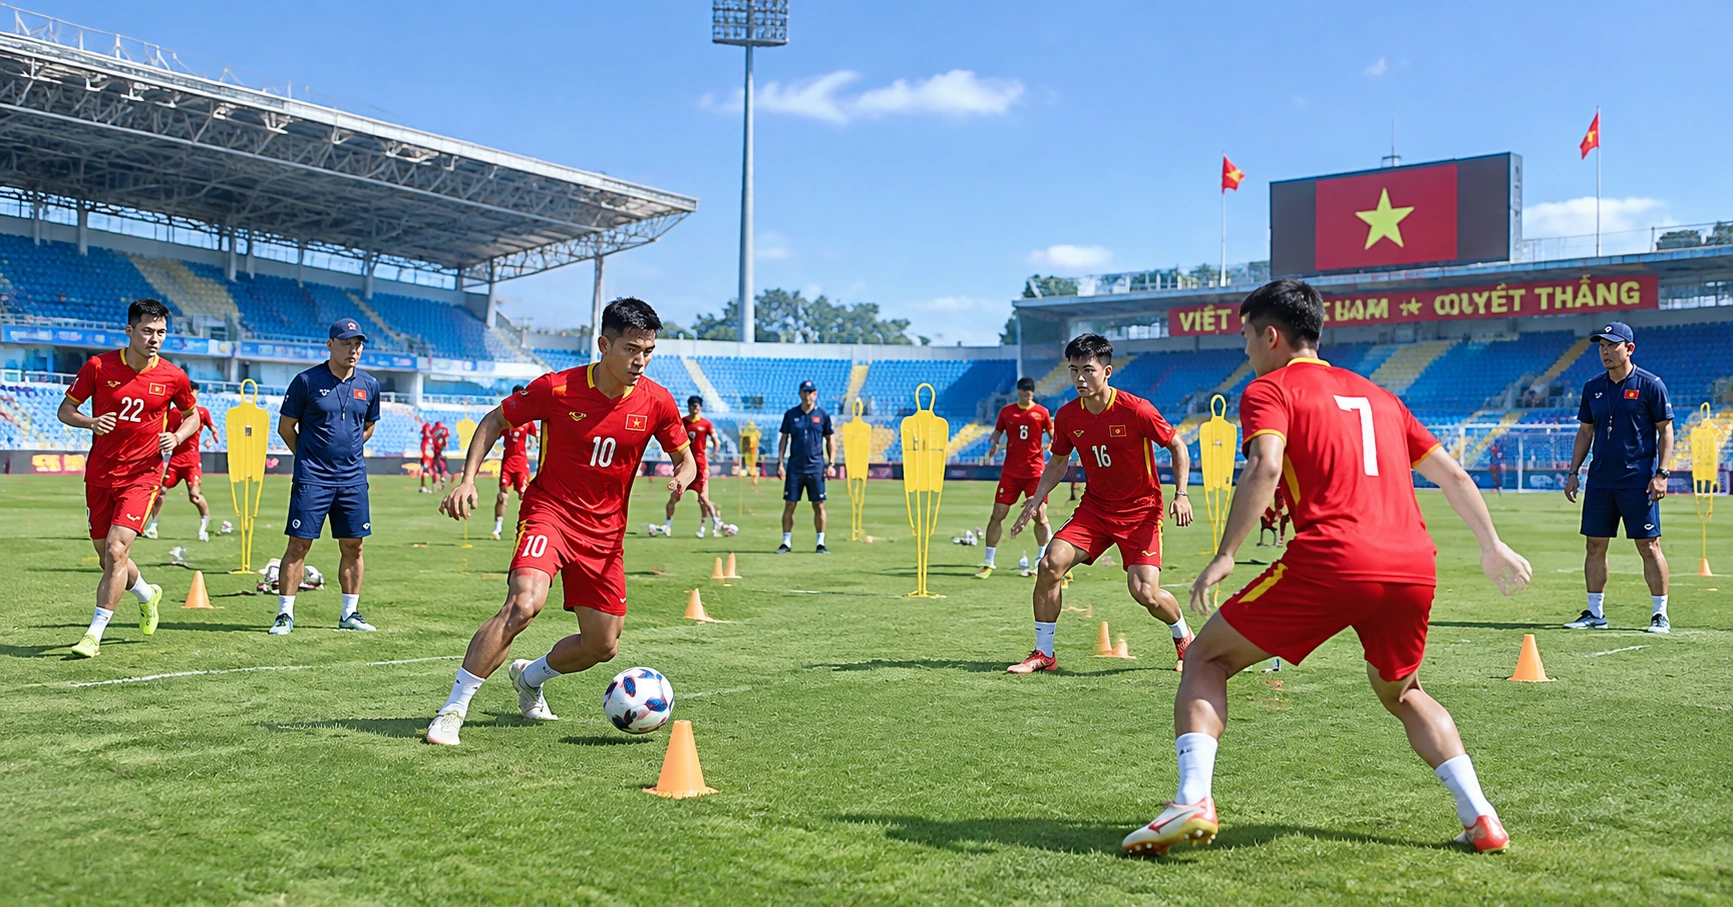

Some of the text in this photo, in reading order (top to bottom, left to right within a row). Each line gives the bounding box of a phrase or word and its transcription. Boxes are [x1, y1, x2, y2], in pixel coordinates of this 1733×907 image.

[118, 396, 144, 423] 22
[1333, 394, 1379, 476] 7
[590, 436, 616, 468] 10
[1092, 445, 1112, 467] 16
[521, 534, 548, 558] 10
